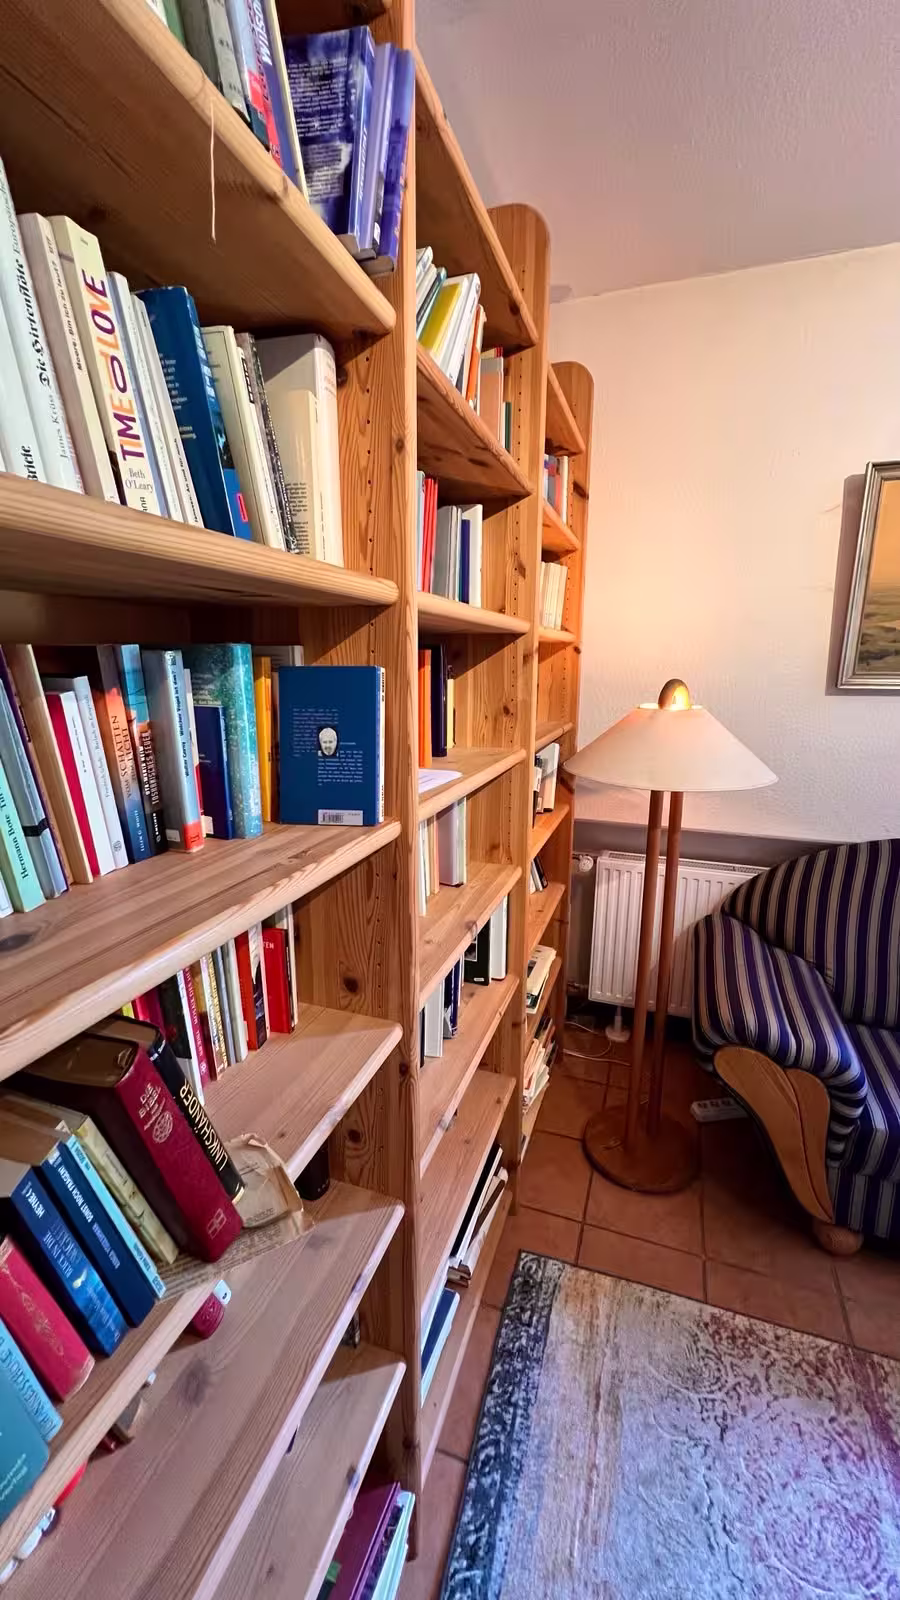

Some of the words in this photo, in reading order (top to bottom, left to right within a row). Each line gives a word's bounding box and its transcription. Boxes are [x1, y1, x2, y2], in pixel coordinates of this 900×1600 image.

[63, 301, 71, 315] ich
[82, 268, 119, 351] LOVE
[66, 315, 75, 336] Bin
[36, 362, 51, 388] Die
[110, 394, 145, 462] TIME
[128, 467, 146, 480] Beth
[125, 479, 154, 494] O'Leary
[112, 716, 127, 777] SCHATTEN
[121, 728, 134, 764] LICHT
[143, 730, 152, 754] FEUER
[121, 780, 132, 797] VOM
[4, 813, 15, 837] Bote
[10, 836, 28, 880] Hermann
[178, 1079, 229, 1172] LINKSHÄNDER
[28, 1193, 46, 1219] HEYNE
[70, 1187, 85, 1205] NOCH
[79, 1202, 94, 1222] SONST
[55, 1254, 74, 1278] BLICK
